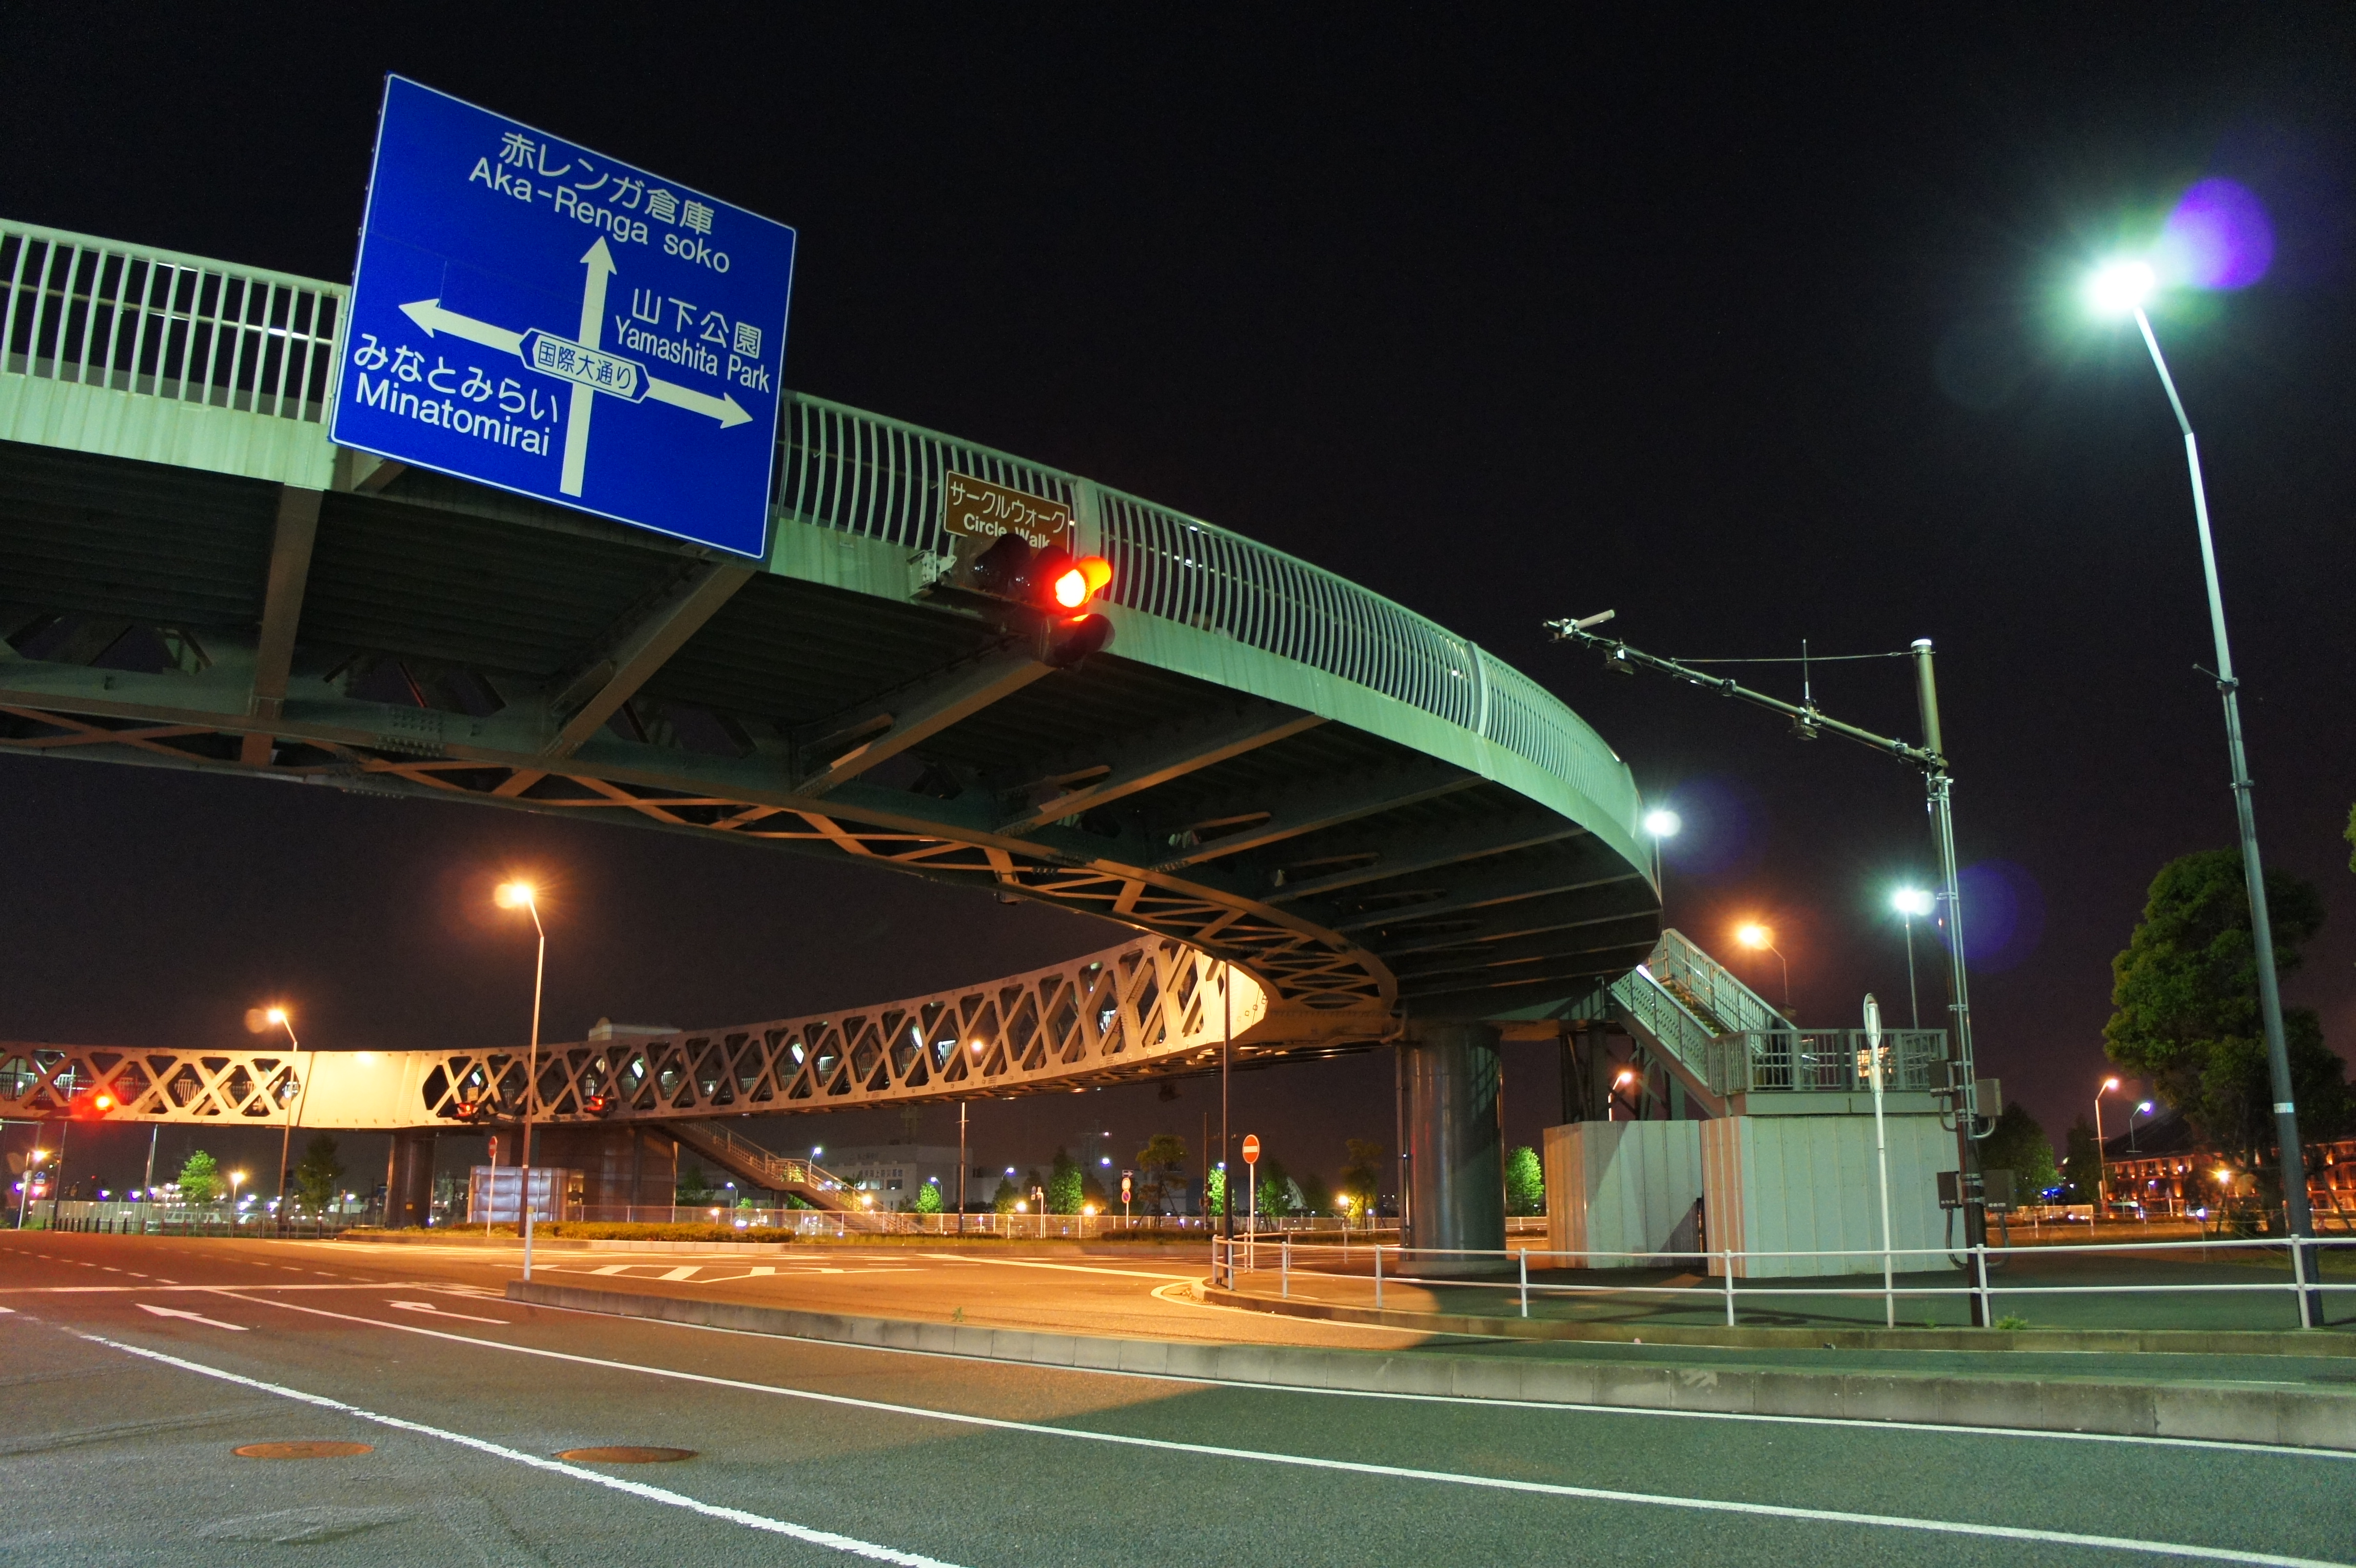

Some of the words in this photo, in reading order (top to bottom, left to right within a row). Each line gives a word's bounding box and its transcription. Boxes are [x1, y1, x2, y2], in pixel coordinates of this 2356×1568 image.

[468, 157, 648, 245] Aka-Renga
[663, 233, 730, 273] soko
[499, 132, 714, 235] 赤レンガ倉庫
[615, 315, 718, 376] Yamashita
[727, 354, 770, 394] Park
[632, 288, 762, 359] 山下公園
[354, 333, 558, 423] みなとみらい
[538, 341, 631, 389] 国際大通り
[356, 371, 550, 457] Minatomirai
[950, 481, 1065, 534] サークルウォーク
[964, 513, 1007, 537] Circle
